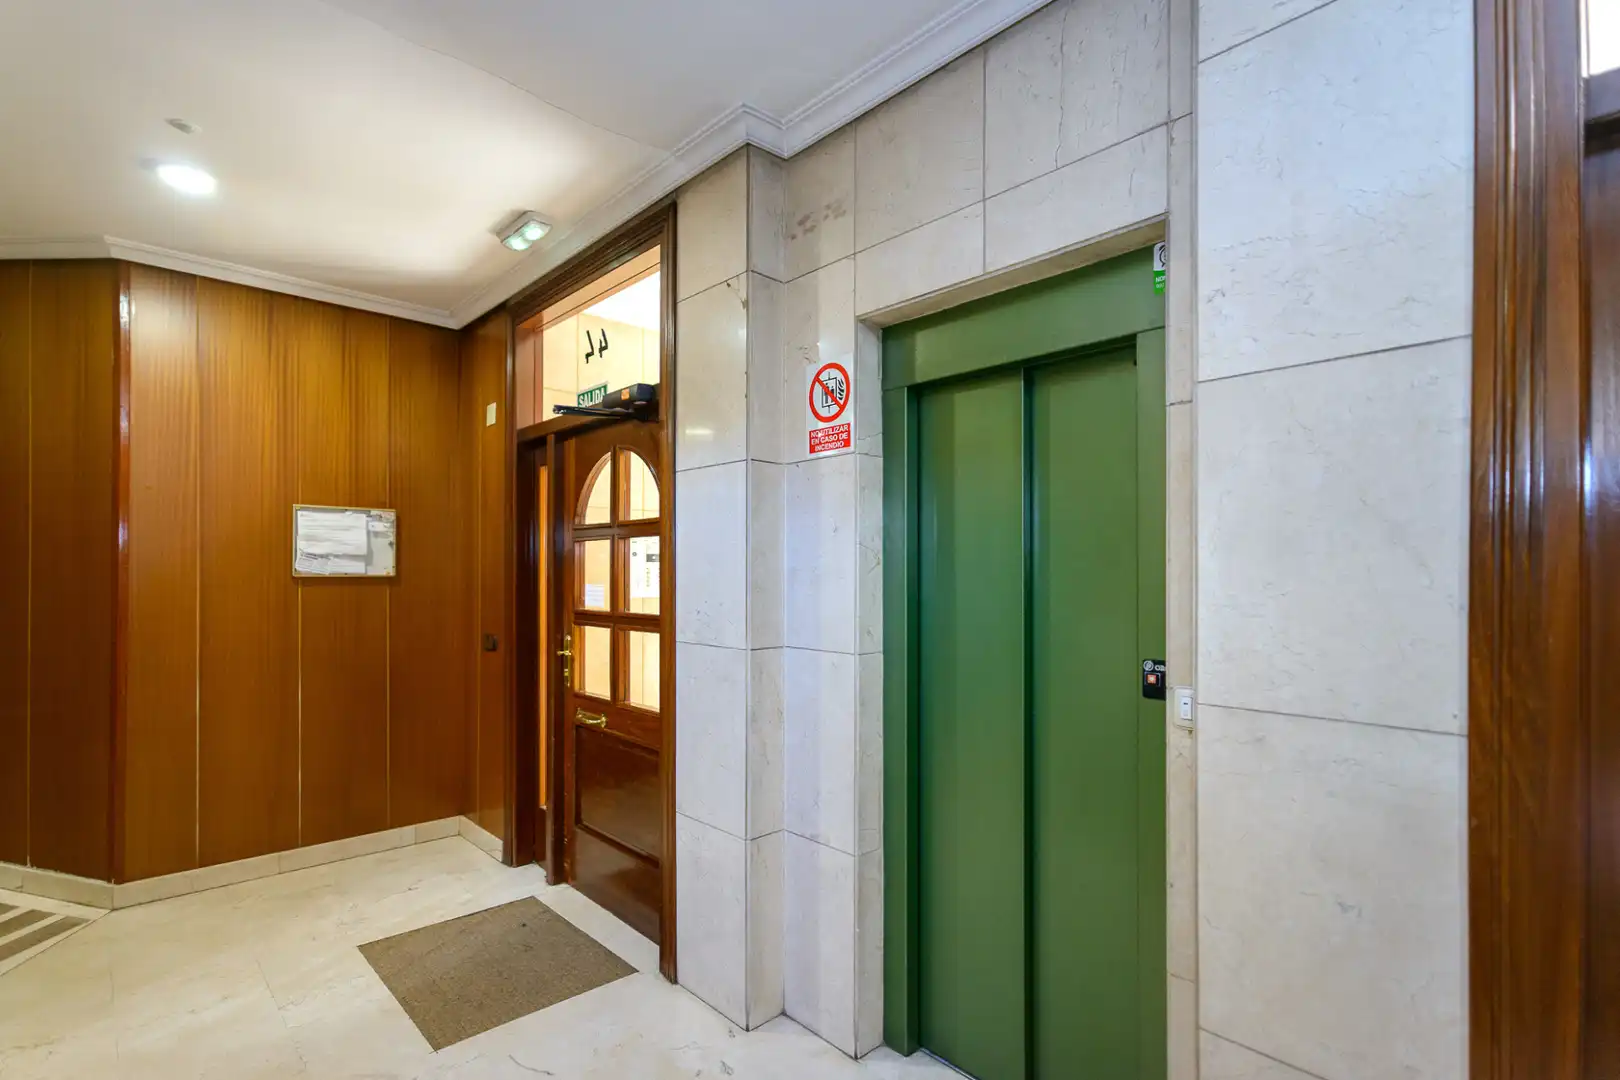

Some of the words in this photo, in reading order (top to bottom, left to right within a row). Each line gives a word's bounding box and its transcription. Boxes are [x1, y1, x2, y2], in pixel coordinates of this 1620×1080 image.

[578, 387, 605, 407] SALIDA
[820, 425, 848, 434] UTILIZAR
[820, 434, 838, 443] CASO
[839, 432, 848, 440] DE
[815, 441, 844, 451] INCENDIO
